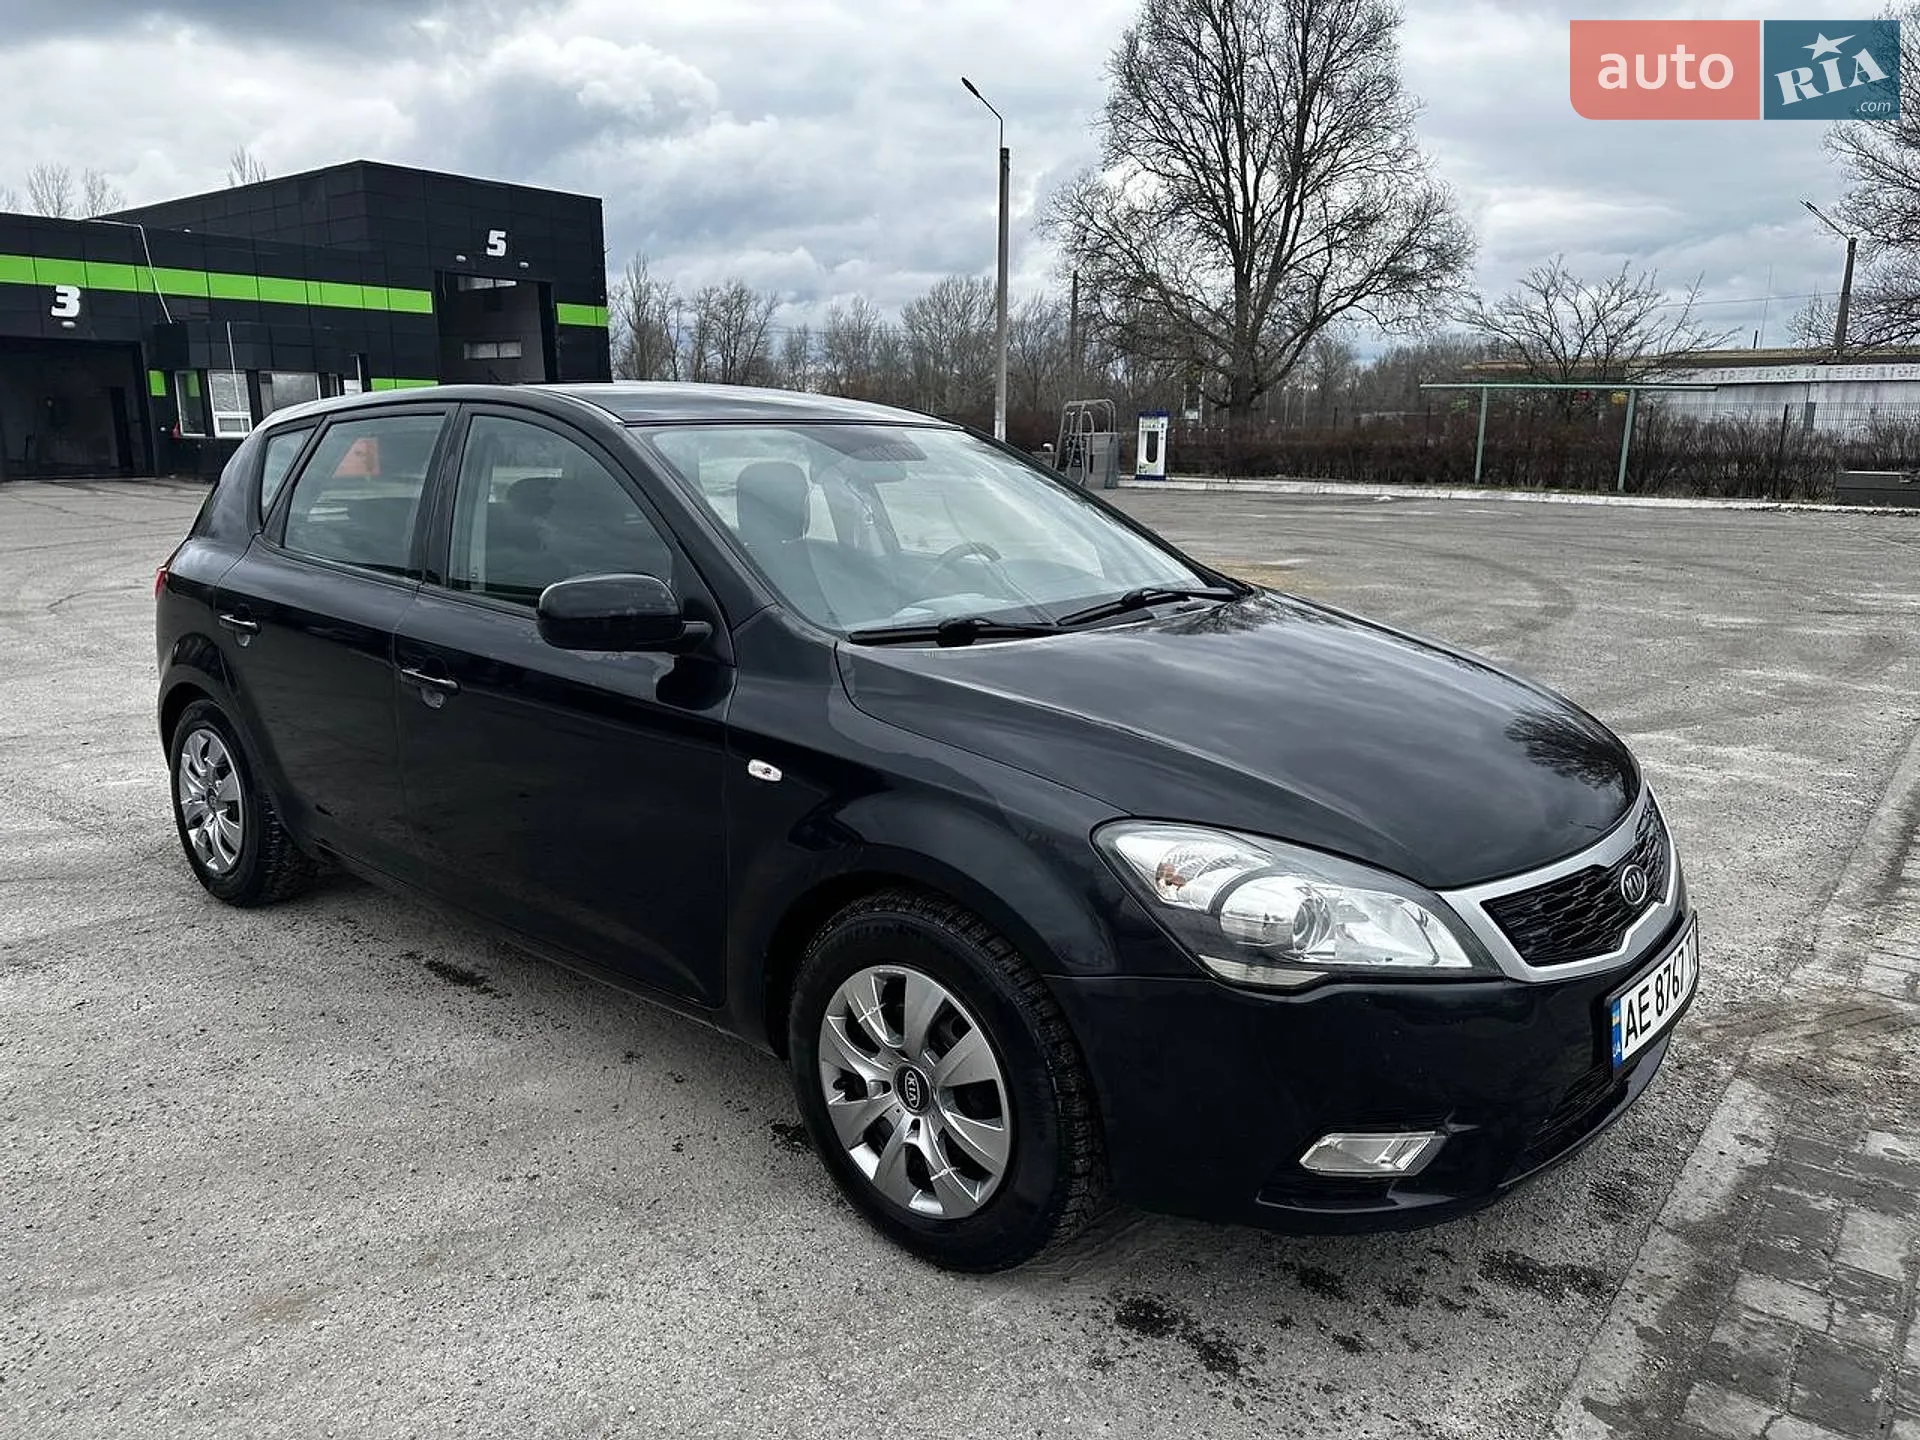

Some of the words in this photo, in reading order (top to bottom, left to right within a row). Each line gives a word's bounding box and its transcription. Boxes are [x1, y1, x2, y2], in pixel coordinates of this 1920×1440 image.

[487, 230, 506, 256] 5
[51, 284, 80, 317] 3
[1625, 985, 1652, 1048] AE
[1655, 946, 1685, 1017] 8767
